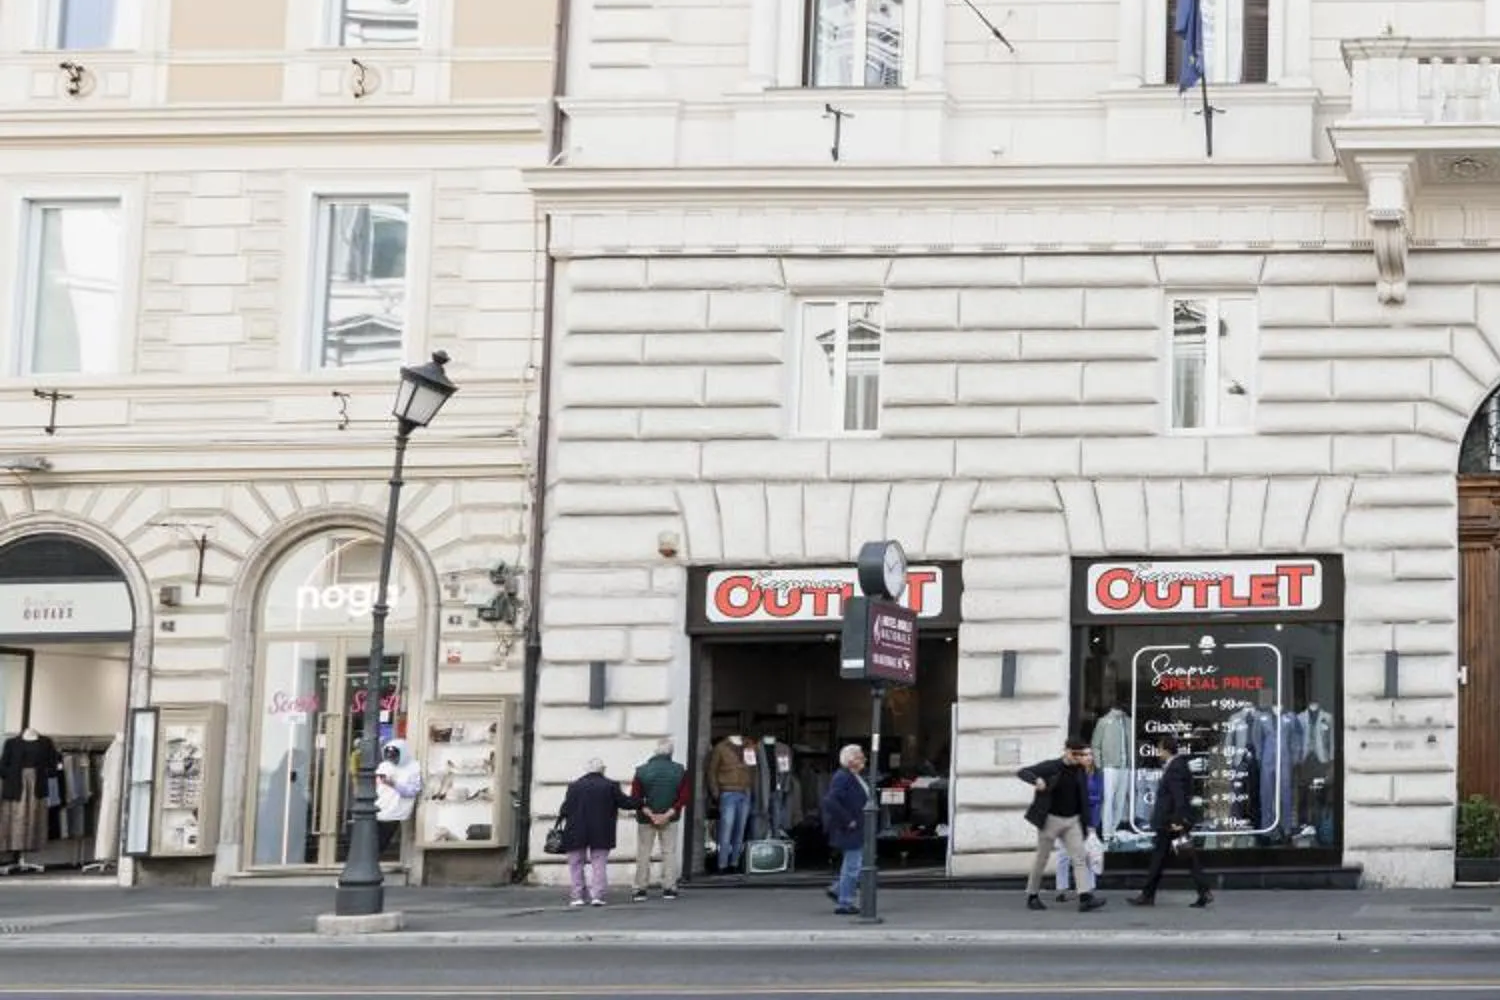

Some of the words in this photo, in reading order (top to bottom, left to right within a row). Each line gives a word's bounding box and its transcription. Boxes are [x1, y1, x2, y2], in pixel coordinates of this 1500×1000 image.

[715, 571, 936, 618] OUTT
[1096, 565, 1315, 611] OUTLET
[1151, 653, 1218, 687] Sempre
[1160, 676, 1218, 691] SPECIAL
[1222, 675, 1265, 690] PRICE
[1161, 697, 1191, 709] Abiti
